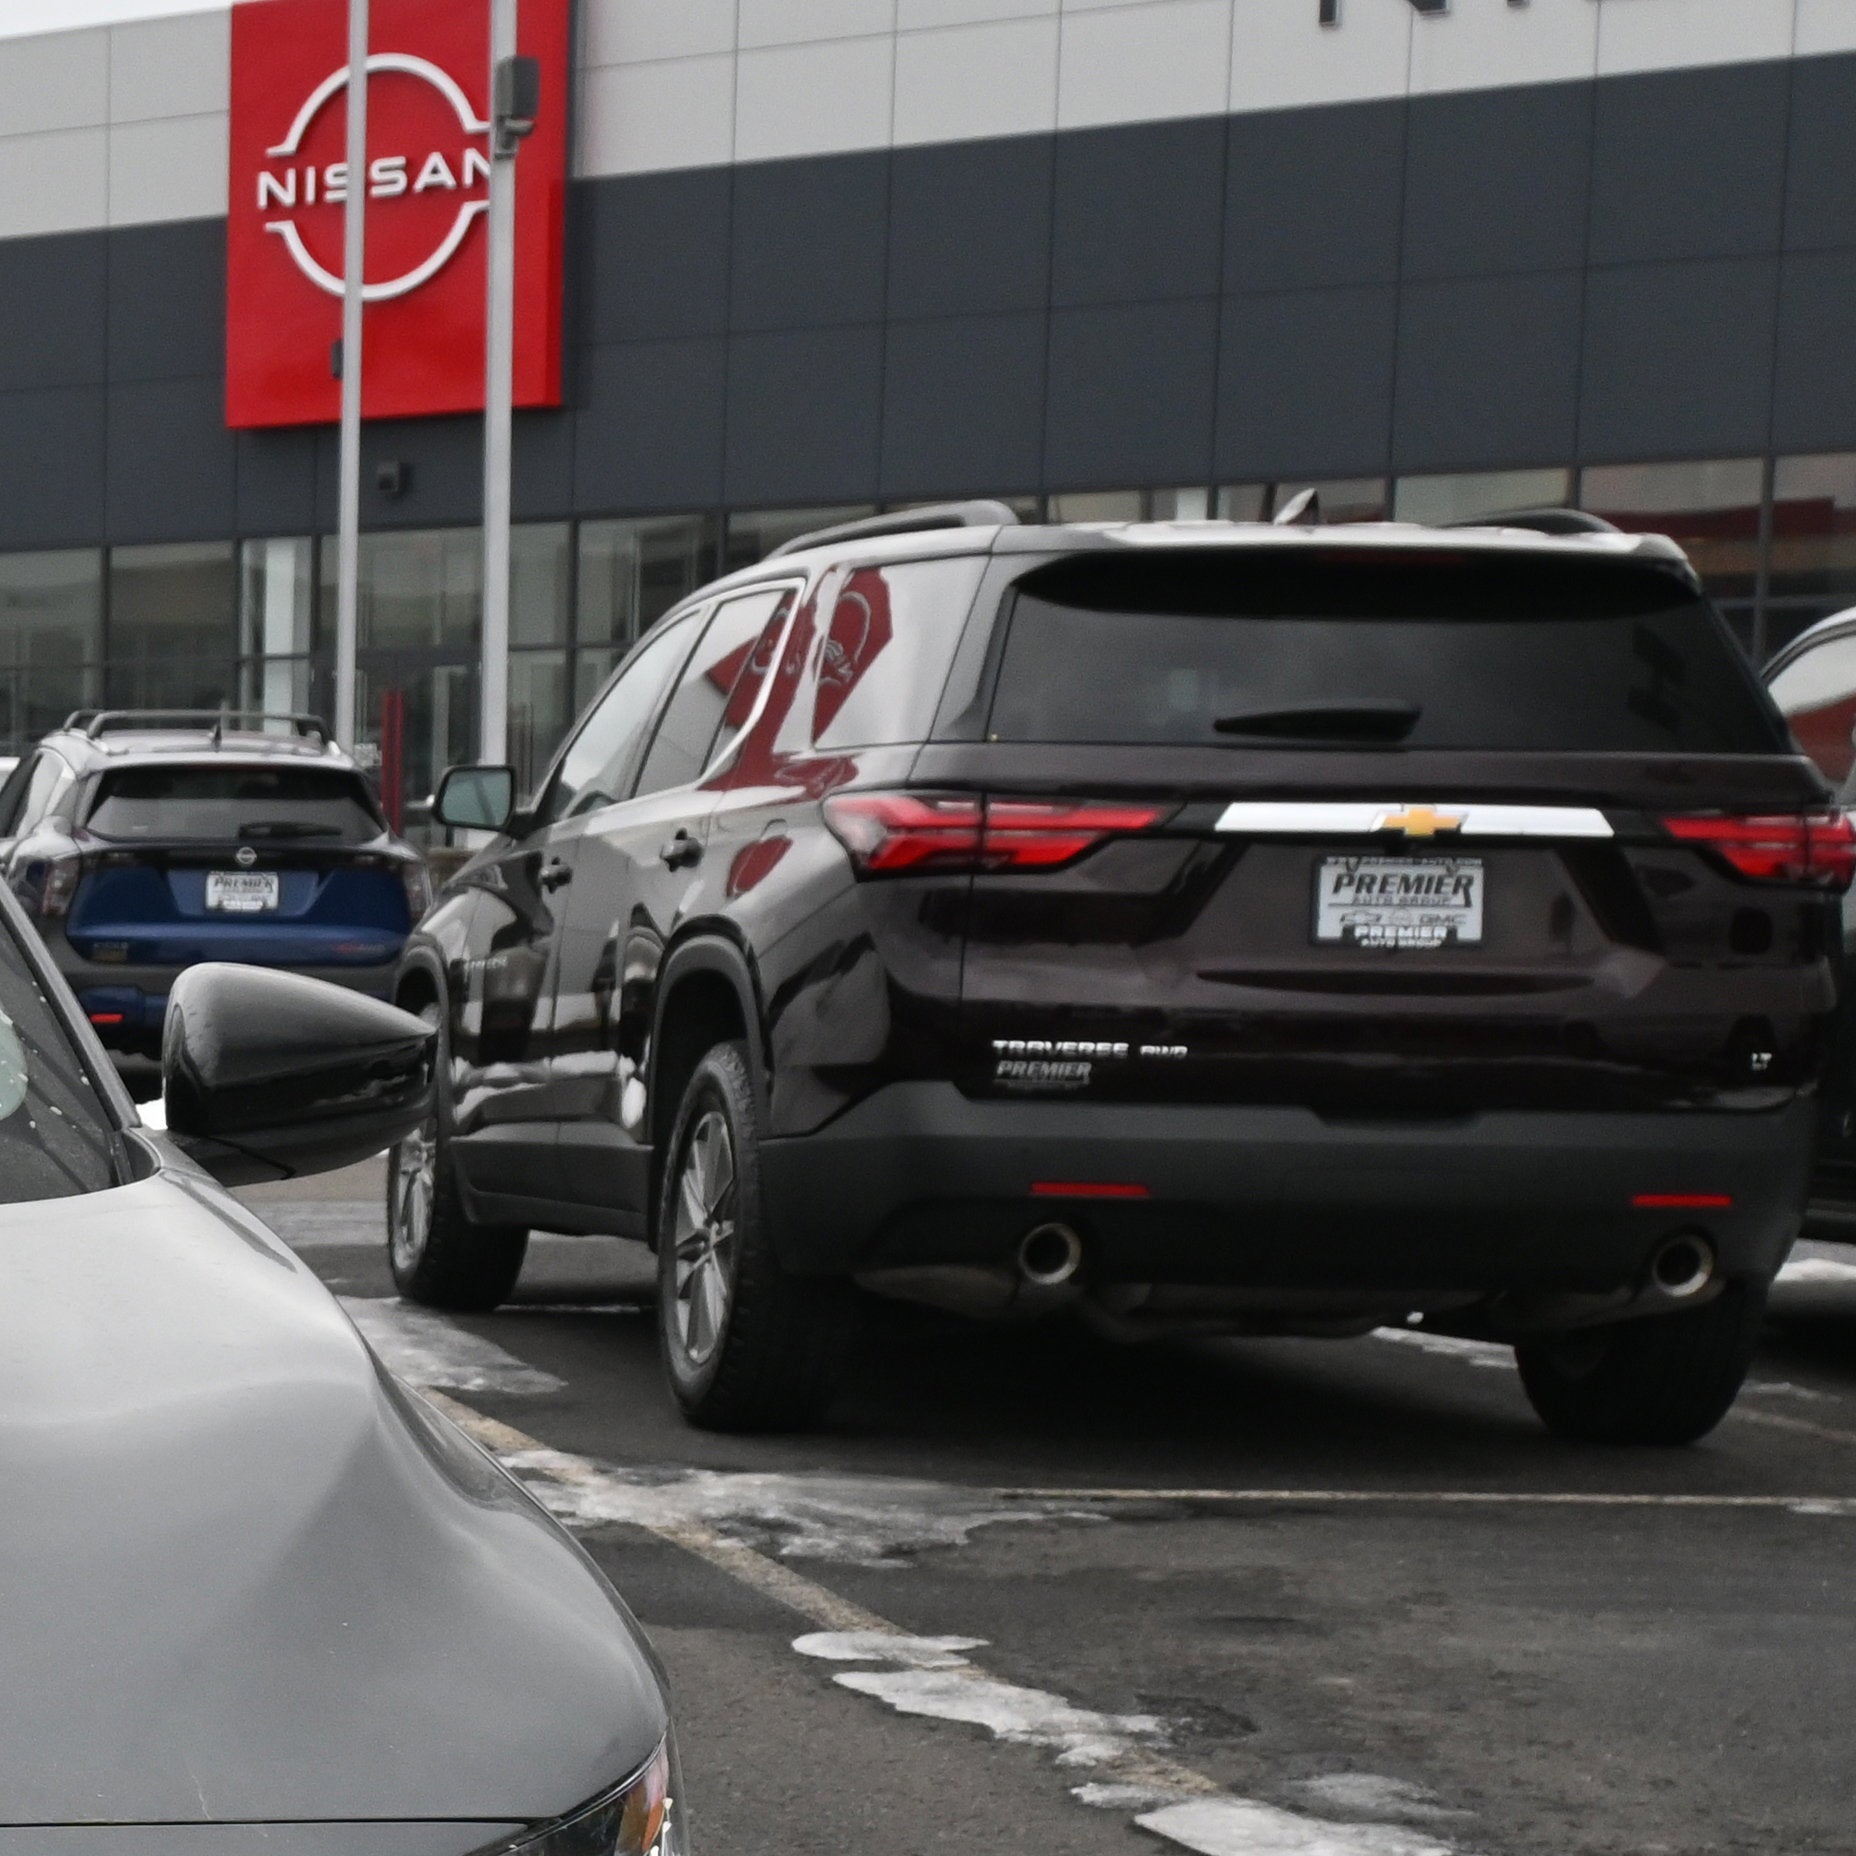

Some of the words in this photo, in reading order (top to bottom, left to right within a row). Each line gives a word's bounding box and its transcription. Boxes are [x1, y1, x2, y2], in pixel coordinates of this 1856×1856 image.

[257, 147, 490, 209] NISSAN
[1332, 873, 1475, 906] PREMIER
[1354, 926, 1447, 937] PREMIER
[996, 1060, 1092, 1083] PREMIER
